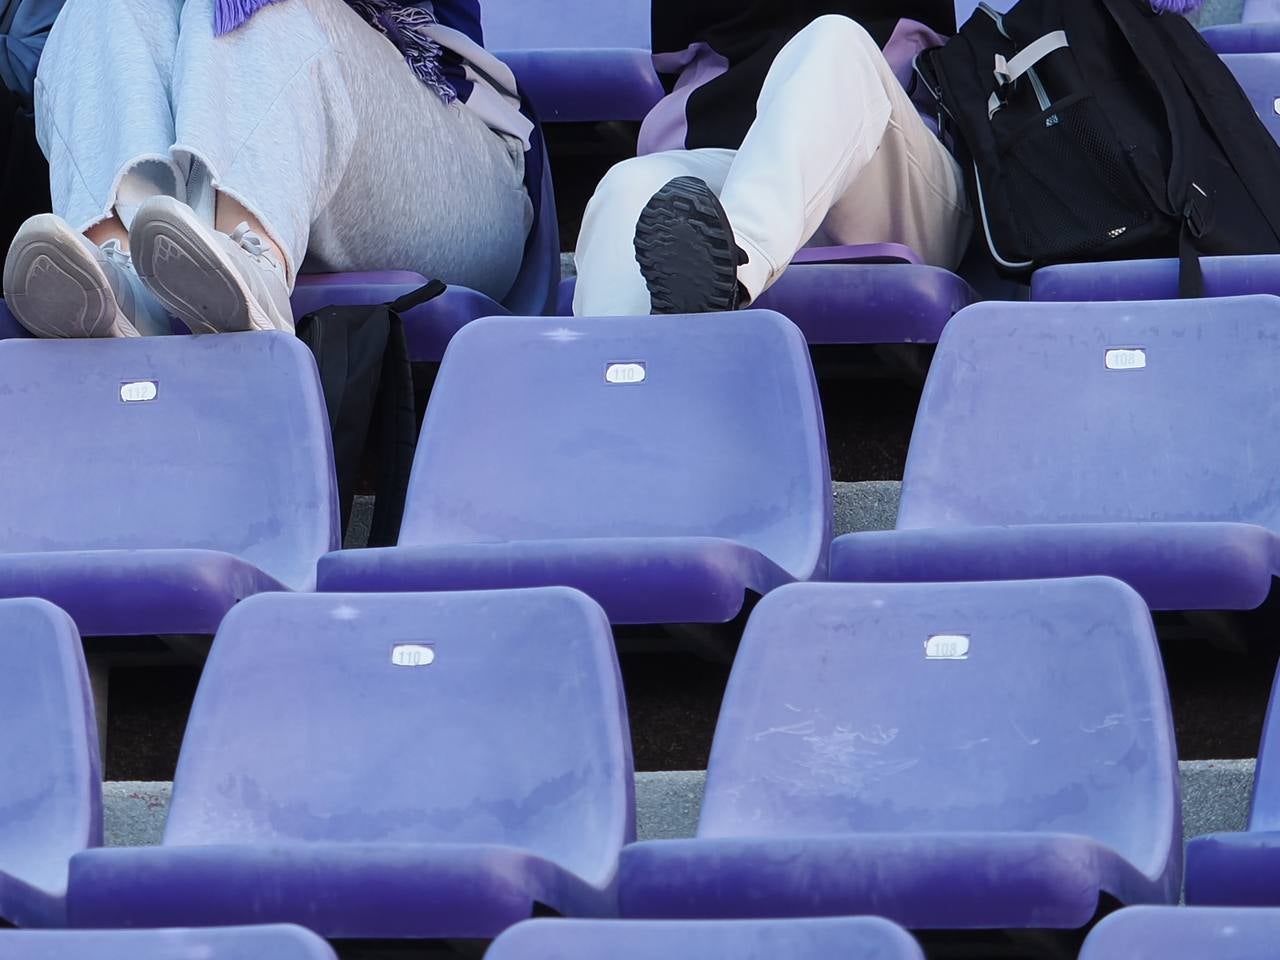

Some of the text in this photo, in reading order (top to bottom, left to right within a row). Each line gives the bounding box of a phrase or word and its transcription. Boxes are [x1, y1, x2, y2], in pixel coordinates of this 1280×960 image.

[614, 367, 634, 381] 110
[127, 386, 148, 399] 112
[934, 642, 957, 656] 108
[400, 651, 421, 664] 110
